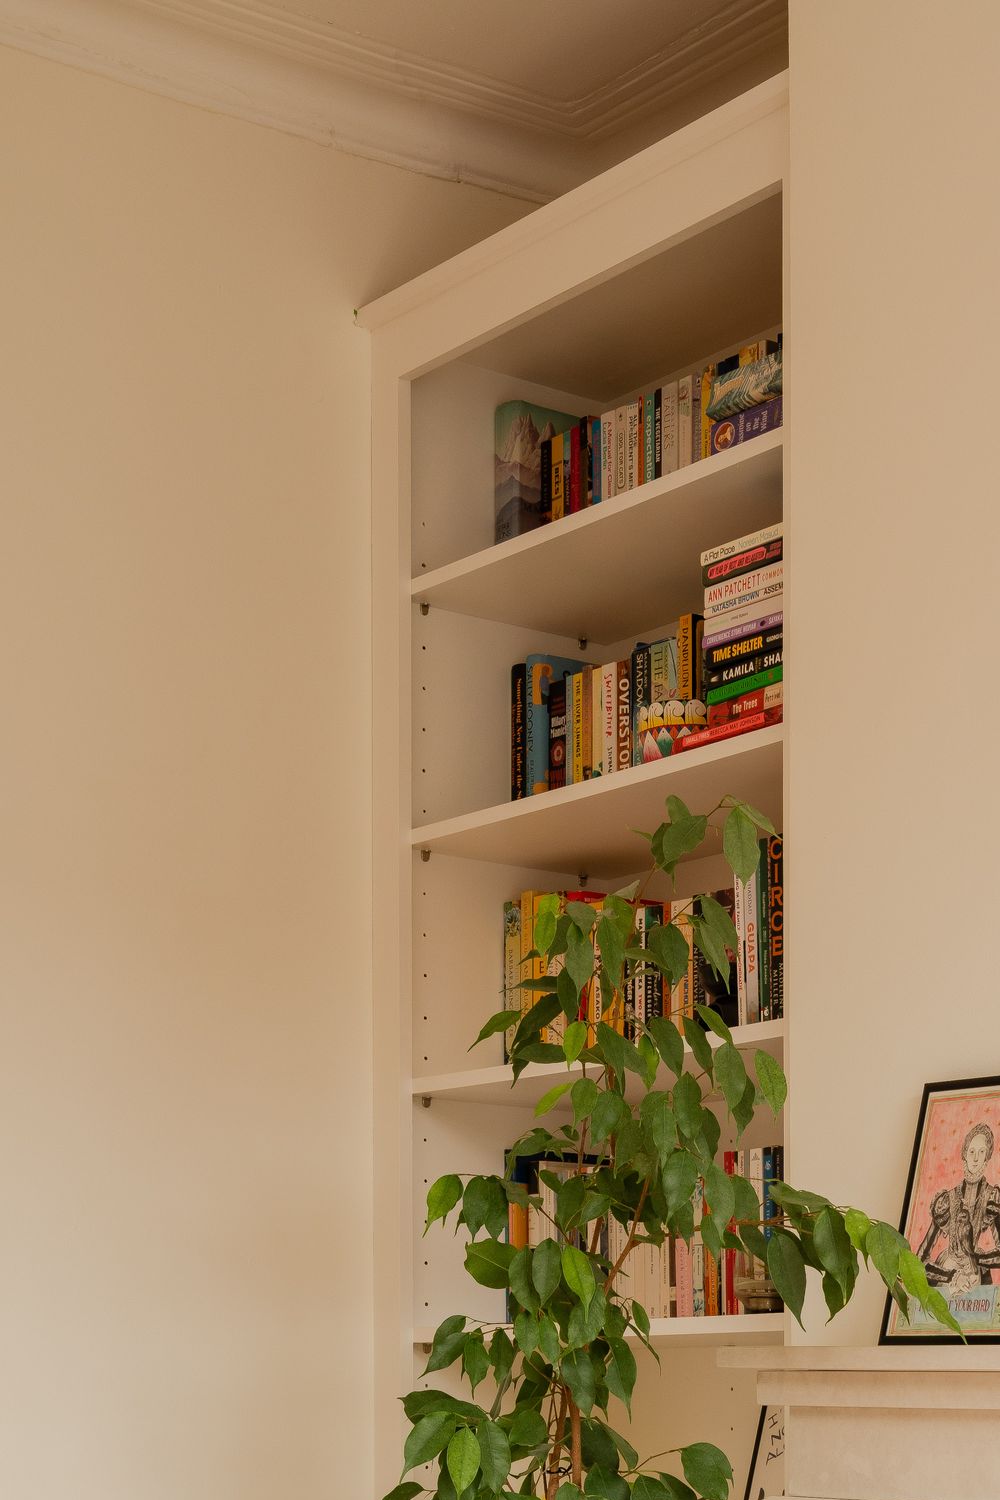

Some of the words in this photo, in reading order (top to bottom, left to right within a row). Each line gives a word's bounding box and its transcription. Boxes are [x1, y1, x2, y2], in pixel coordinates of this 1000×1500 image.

[553, 467, 561, 495] BEES
[704, 554, 709, 563] A
[709, 551, 719, 562] Flat
[719, 545, 736, 559] Place
[708, 587, 723, 603] ANN
[724, 573, 761, 597] PATCHETT
[711, 598, 737, 614] NATASHA
[738, 590, 760, 604] BROWN
[681, 627, 689, 688] DANDELION
[713, 646, 732, 663] TIME
[732, 636, 763, 657] SHELTER
[654, 647, 663, 681] THE
[722, 661, 755, 681] KAMILA
[732, 704, 742, 715] The
[743, 698, 758, 711] Trees
[770, 838, 783, 957] CIRCE
[747, 922, 755, 973] GUAPA
[955, 1299, 972, 1312] YOUR
[972, 1298, 991, 1313] BIRD
